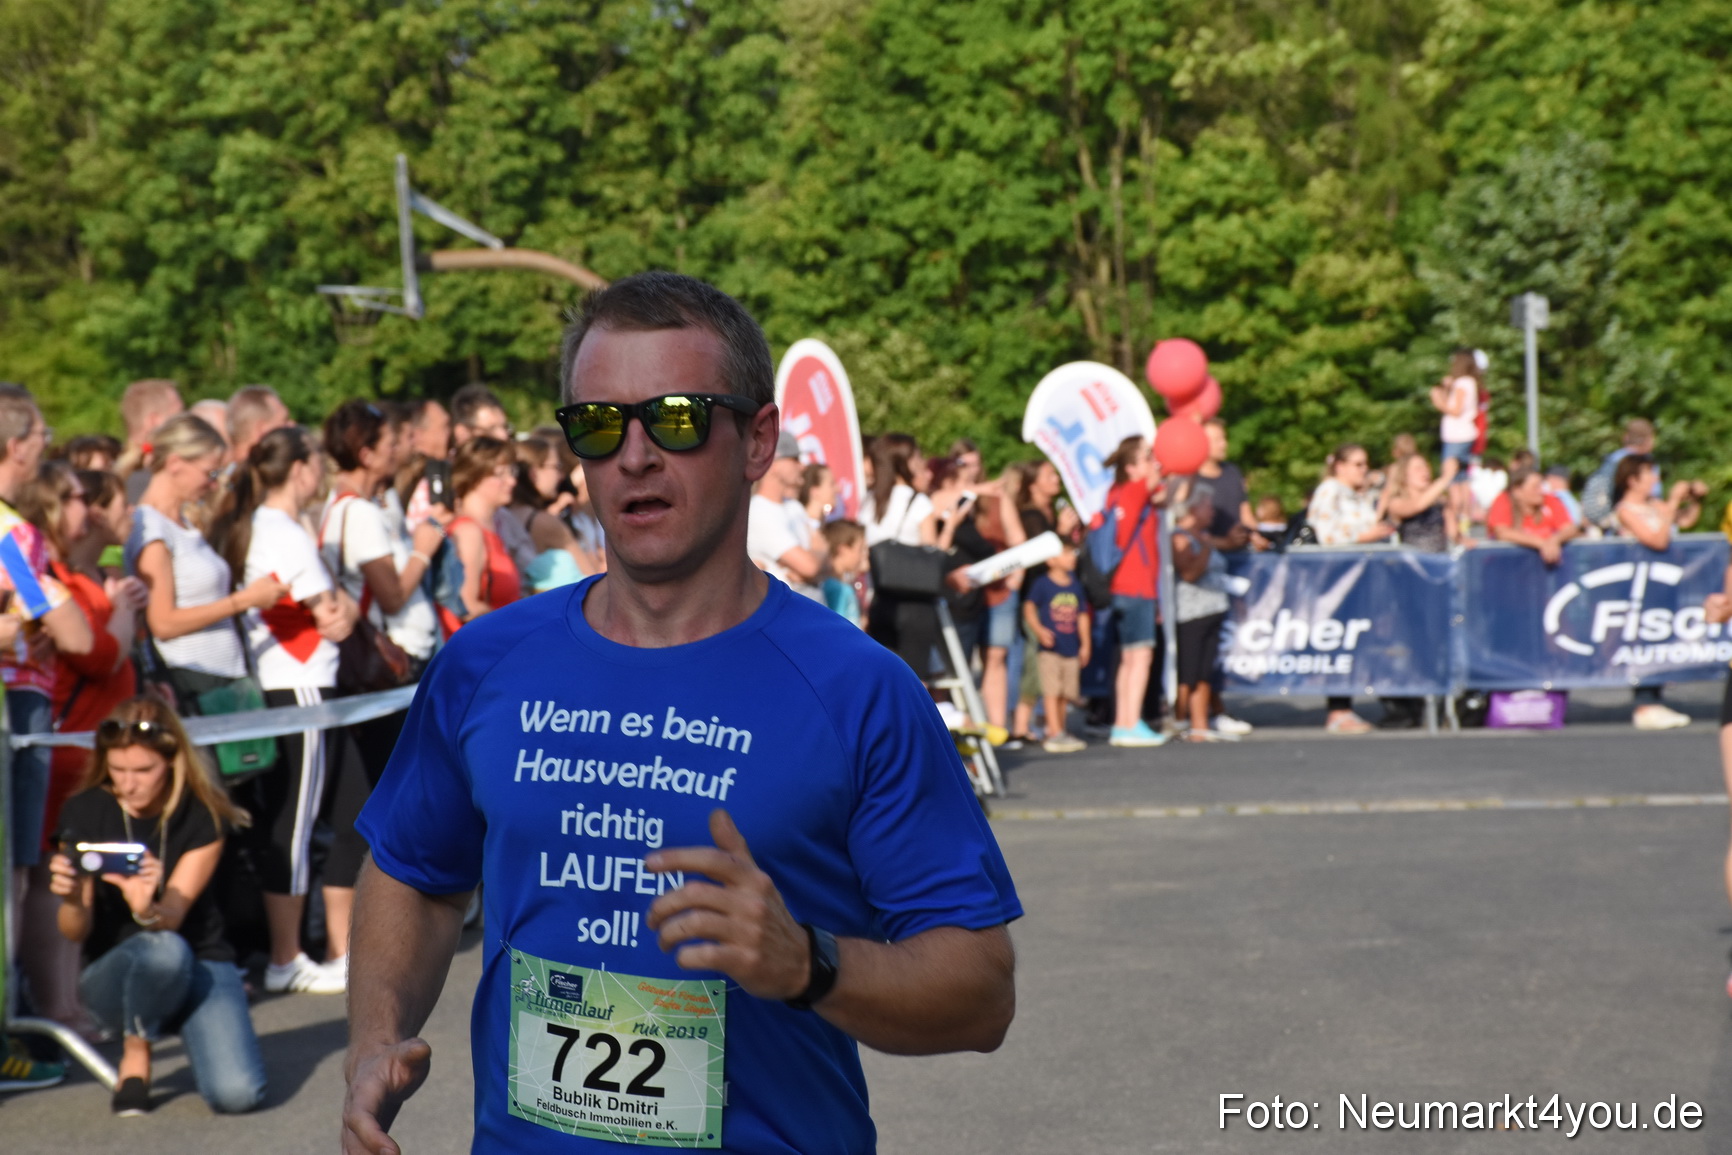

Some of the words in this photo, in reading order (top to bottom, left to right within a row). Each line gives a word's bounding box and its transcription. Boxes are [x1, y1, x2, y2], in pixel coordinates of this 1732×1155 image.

[1590, 599, 1732, 642] Fisc
[1221, 653, 1353, 675] TOMOBILE
[520, 700, 611, 734] Wenn
[620, 712, 654, 737] es
[662, 706, 752, 754] beim
[514, 748, 737, 801] Hausverkauf
[561, 803, 664, 848] richtig
[540, 852, 684, 896] LAUFEN
[577, 910, 640, 948] soll!
[535, 990, 615, 1020] firmenlauf
[665, 1025, 708, 1039] 2019
[547, 1022, 666, 1098] 722
[536, 1097, 586, 1120] Feldbusch
[590, 1111, 652, 1129] Immobilien
[655, 1120, 678, 1131] e.K.
[553, 1085, 602, 1109] Bublik
[607, 1096, 658, 1116] Dmitri
